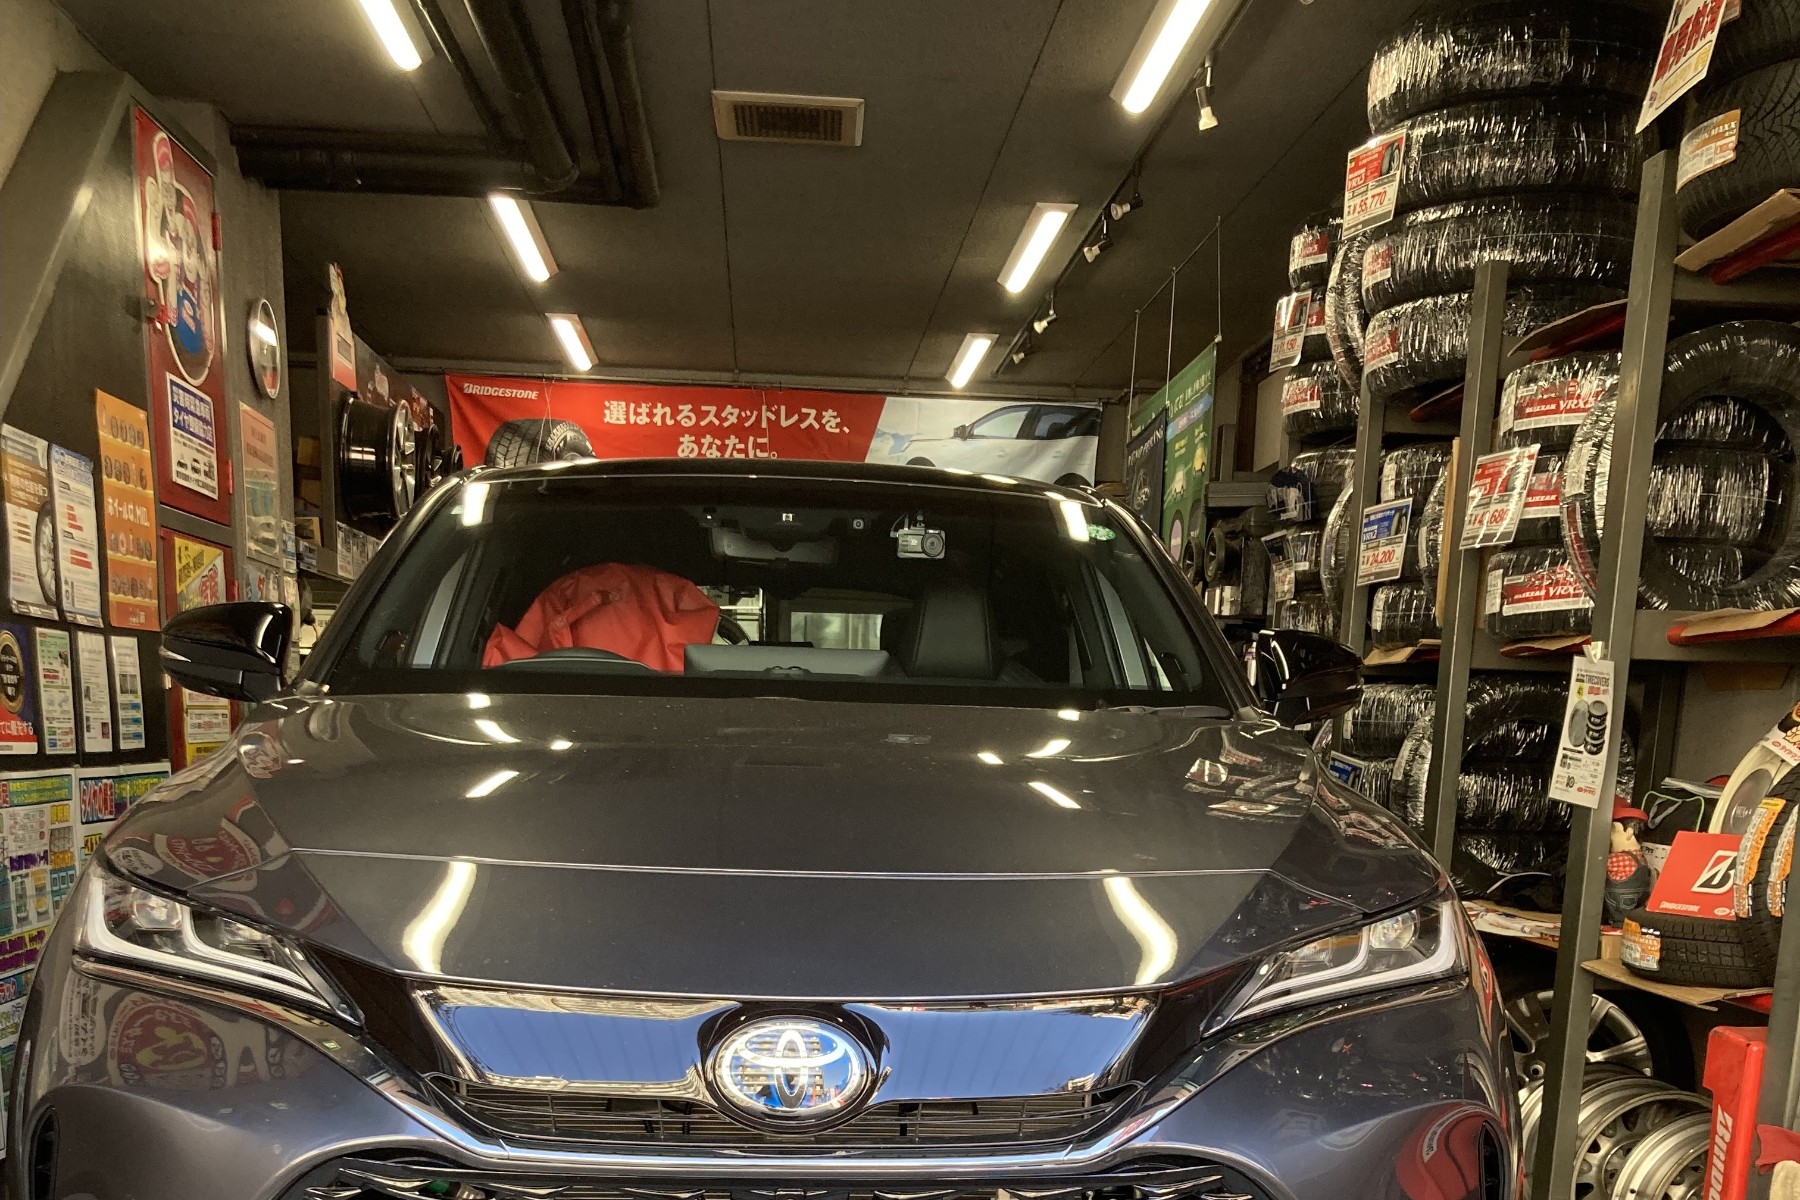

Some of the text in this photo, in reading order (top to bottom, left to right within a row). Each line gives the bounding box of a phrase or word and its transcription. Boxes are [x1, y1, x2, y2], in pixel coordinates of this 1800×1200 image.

[463, 382, 539, 400] BRIDGESTONE
[603, 399, 850, 434] 選ばれるスタッドレスを、
[676, 434, 779, 460] あなたに。
